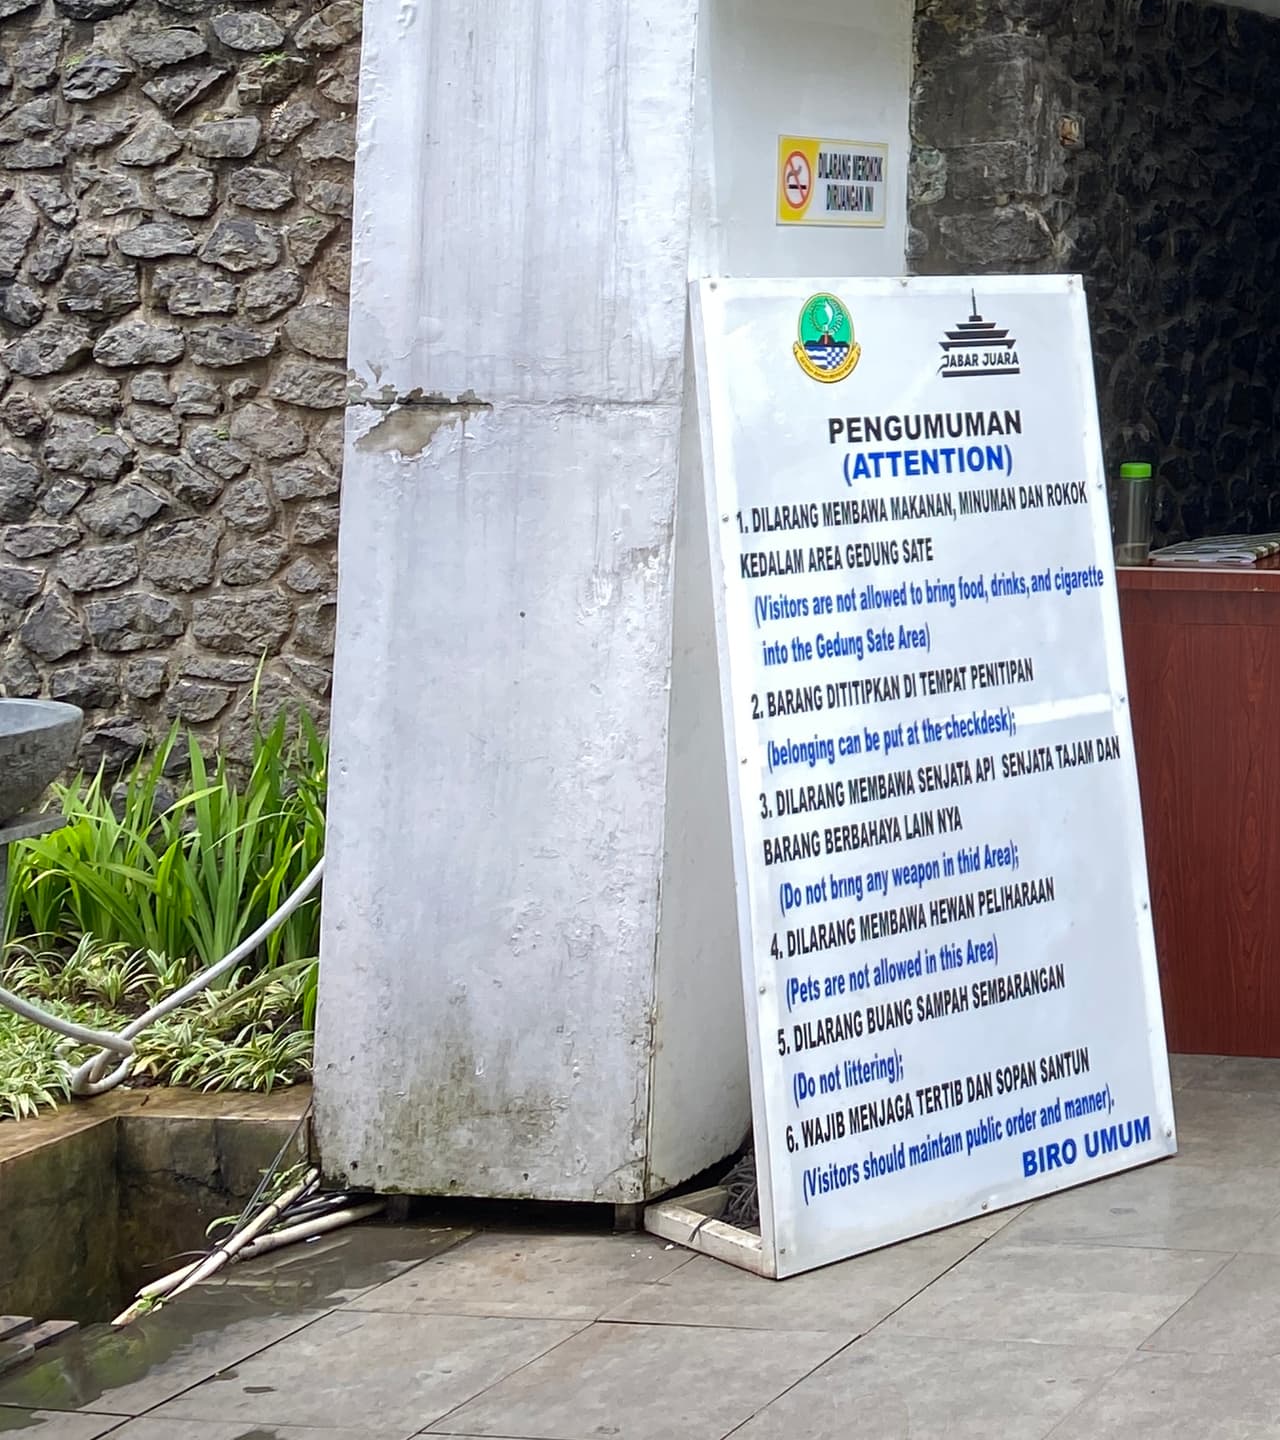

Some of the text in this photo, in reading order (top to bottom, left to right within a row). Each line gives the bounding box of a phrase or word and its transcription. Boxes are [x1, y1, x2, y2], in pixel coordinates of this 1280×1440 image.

[941, 351, 1020, 369] JABAR JUARA
[828, 410, 1022, 444] PENGUMUMAN
[843, 445, 1013, 486] (ATTENTION)
[735, 510, 749, 534] 1.
[751, 503, 819, 533] DILARANG
[821, 498, 888, 527] MEMBAWA
[958, 487, 1017, 515] MINUMAN
[1018, 484, 1044, 510] DAN
[1046, 481, 1088, 507] ROKOK
[740, 537, 934, 579] KEDALAM AREA GEDUNG SATE
[762, 622, 931, 666] into the Gedung Sate Area)
[750, 658, 1034, 720] 2. BARANG DITITIPKAN DI TEMPAT PENITIPAN
[759, 792, 773, 820] 3.
[775, 781, 845, 817] DILARANG
[847, 770, 916, 805] MEMBAWA
[917, 760, 973, 793] SENJATA
[1001, 747, 1054, 778] SENJATA
[1055, 739, 1095, 769] TAJAM
[1096, 735, 1121, 762] DAN
[763, 805, 963, 866] BARANG BERBAHAYA LAIN NYA
[779, 882, 802, 917] (Do
[805, 877, 828, 905] not
[829, 873, 864, 902] bring
[866, 870, 889, 897] any
[891, 860, 940, 889] weapon
[942, 851, 955, 877] in
[956, 845, 981, 875] thid
[770, 877, 1055, 961] 4. DILARANG MEMBAWA HEWAN PELIHARAAN
[786, 934, 999, 1013] (Pets are not allowed in this Area)
[777, 964, 1065, 1057] 5. DILARANG BUANG SAMPAH SEMBARANGAN
[785, 1047, 1090, 1154] 6. WAJIB MENJAGA TERTIB DAN SOPAN SANTUN
[793, 1071, 816, 1108] (Do
[819, 1064, 842, 1095] not
[803, 1163, 860, 1204] (Visitors
[863, 1142, 906, 1181] should
[908, 1132, 963, 1167] maintain
[965, 1115, 1003, 1156] public
[1005, 1107, 1037, 1137] order
[1039, 1097, 1062, 1128] and
[1022, 1116, 1151, 1178] BIRO UMUM
